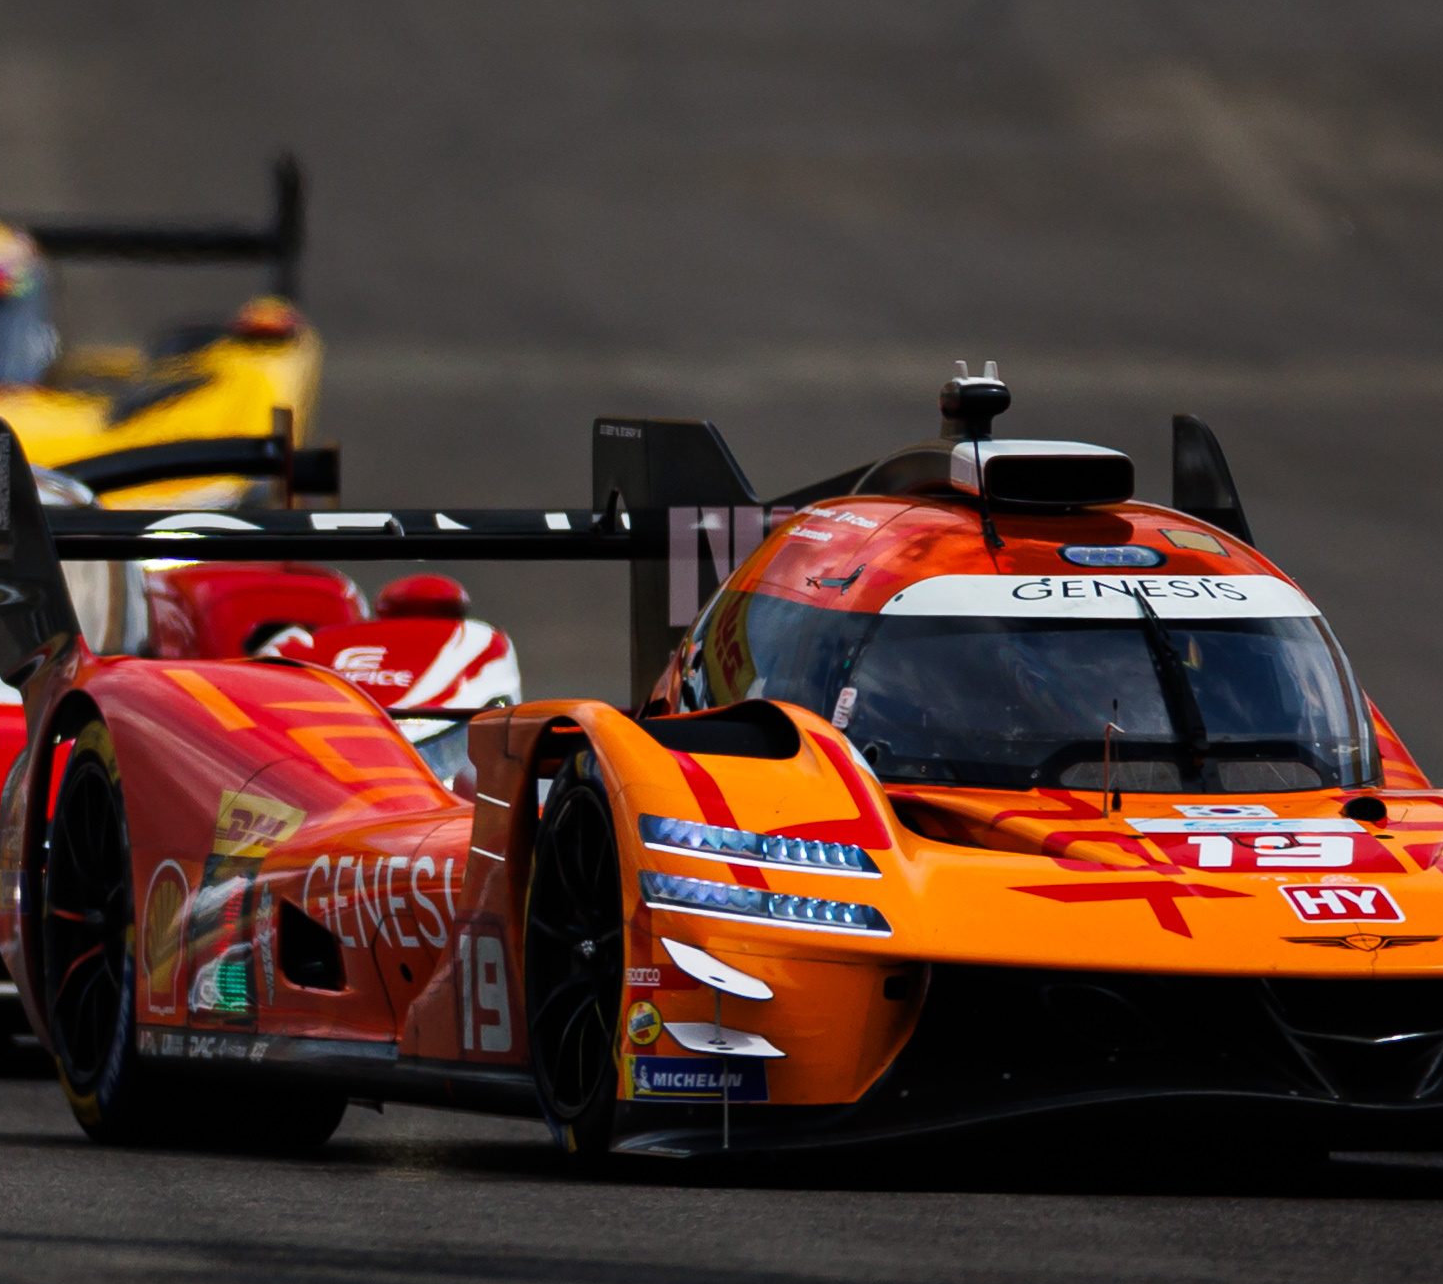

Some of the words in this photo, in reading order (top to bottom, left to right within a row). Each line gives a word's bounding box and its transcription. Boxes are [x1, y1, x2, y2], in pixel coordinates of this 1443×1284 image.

[1012, 580, 1248, 601] GENESIS
[216, 809, 288, 847] DHL
[1188, 836, 1354, 867] 19
[303, 855, 456, 948] GENESI
[1293, 890, 1376, 915] HY
[459, 934, 511, 1052] 19
[653, 1073, 742, 1087] MICHELIN
